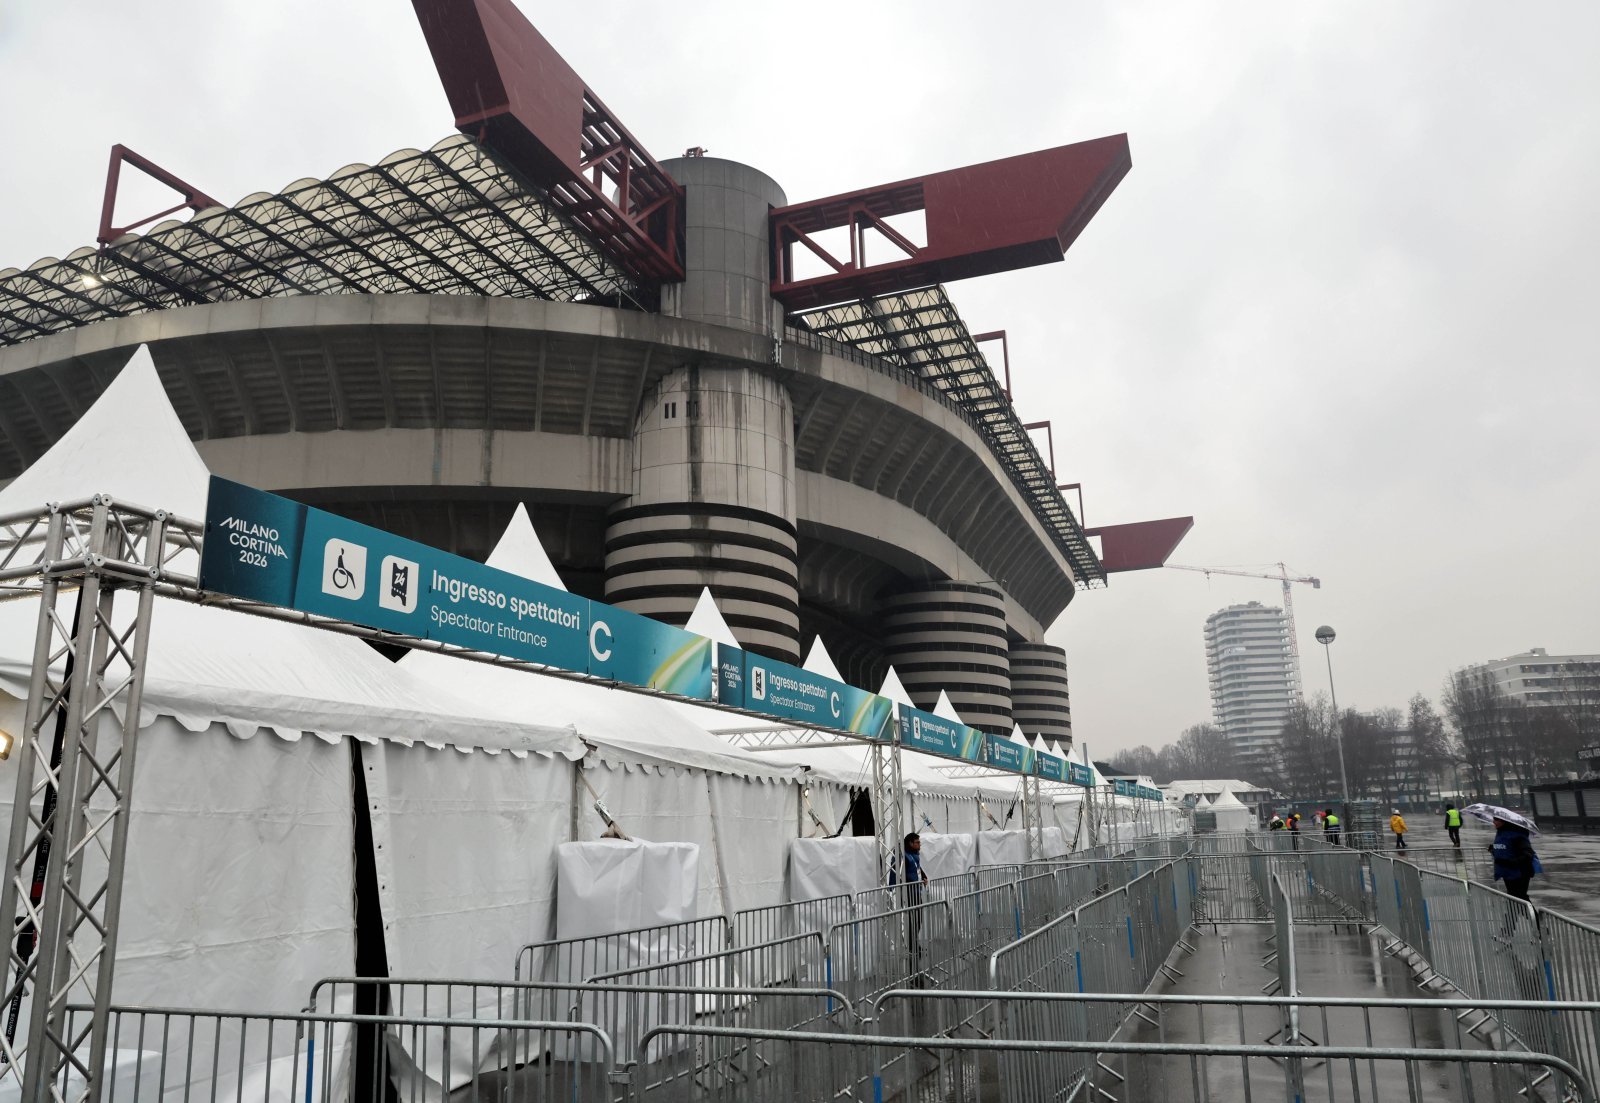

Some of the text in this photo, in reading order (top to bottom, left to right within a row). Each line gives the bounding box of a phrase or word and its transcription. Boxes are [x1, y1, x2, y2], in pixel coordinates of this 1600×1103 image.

[220, 517, 279, 541] MILANO
[229, 533, 288, 560] CORTINA
[239, 550, 268, 568] 2026
[432, 569, 580, 630] Ingresso spettatori
[430, 605, 547, 648] Spectator Entrance
[589, 620, 612, 662] C
[721, 663, 739, 674] MILANO
[724, 671, 743, 682] CORTINA
[769, 671, 828, 699] Ingresso spettatori
[769, 692, 816, 713] Spectator Entrance
[830, 691, 840, 719] C
[950, 729, 957, 749] C
